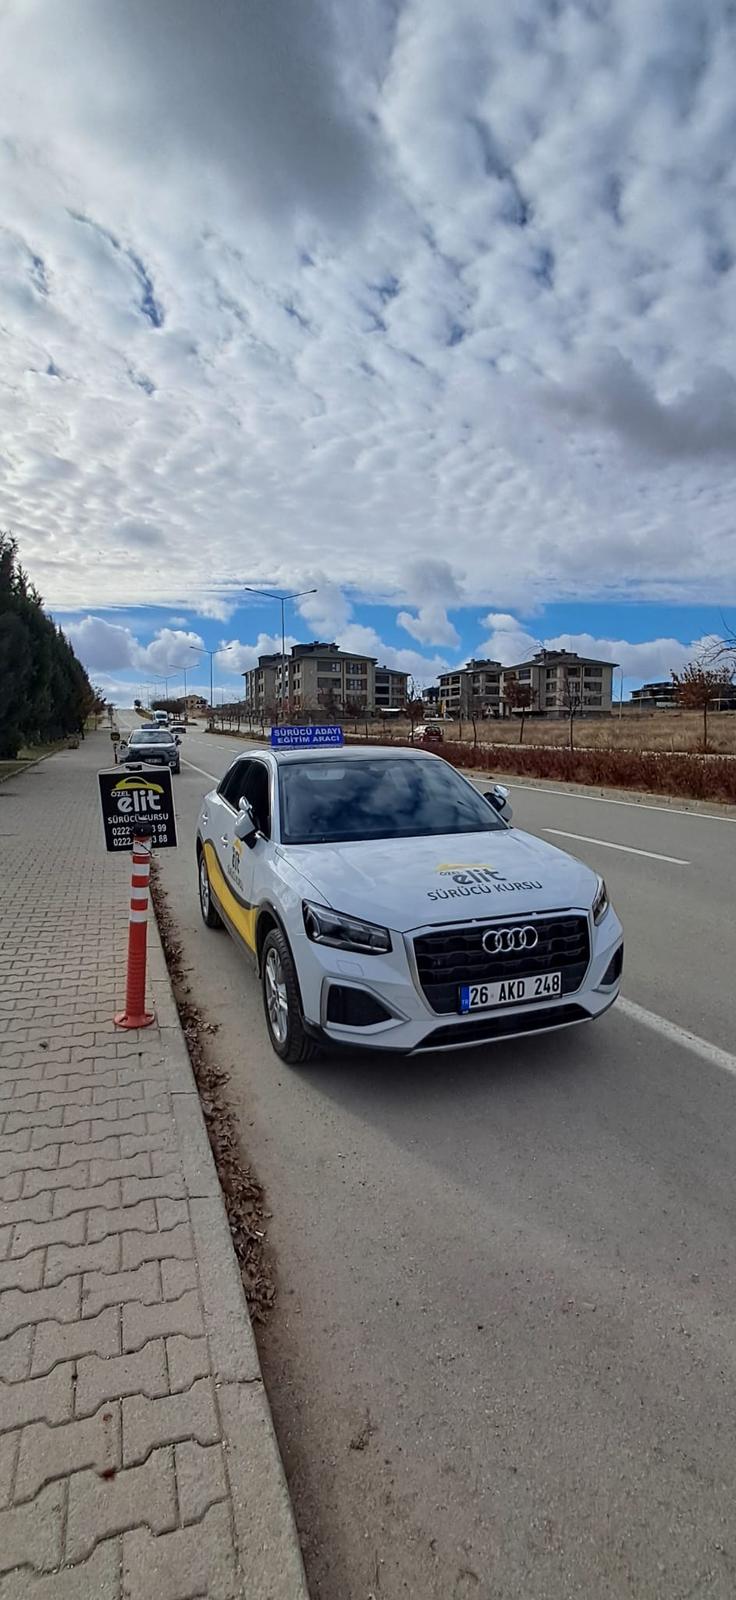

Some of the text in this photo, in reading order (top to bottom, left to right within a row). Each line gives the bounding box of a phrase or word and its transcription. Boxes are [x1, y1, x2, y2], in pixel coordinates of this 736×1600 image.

[274, 728, 312, 736] SÜRÜCÜ
[277, 735, 310, 744] EĞİTİM
[117, 790, 161, 812] elit
[112, 826, 131, 836] 0222
[113, 837, 132, 846] 0222
[452, 868, 507, 885] elit
[427, 881, 543, 901] SÜRÜCÜ KURSU
[470, 986, 488, 1006] 26
[498, 980, 525, 1002] AKD
[534, 975, 560, 995] 248
